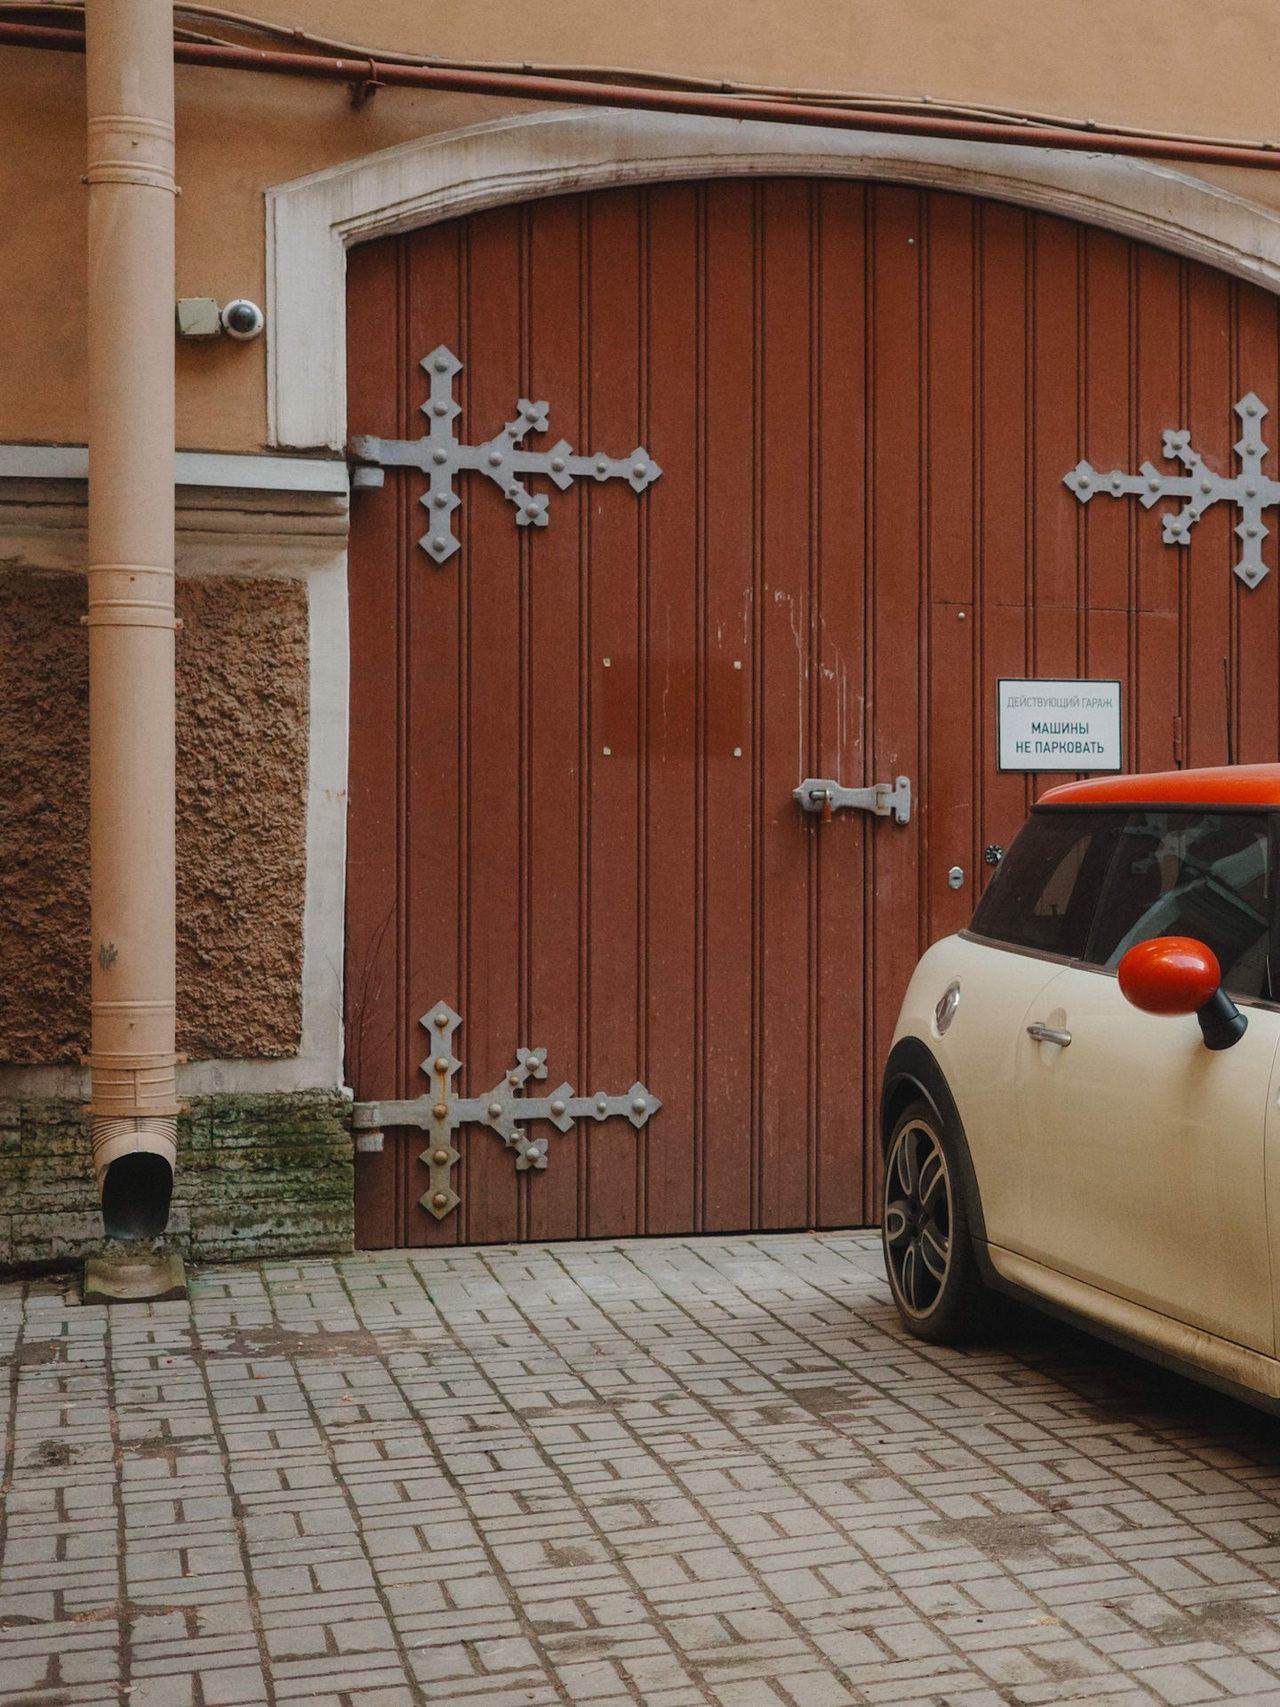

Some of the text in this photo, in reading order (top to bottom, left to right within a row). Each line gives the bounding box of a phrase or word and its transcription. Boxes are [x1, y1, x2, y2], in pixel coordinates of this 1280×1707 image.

[1007, 696, 1112, 709] ДЕЙСТВУЮЩИЙ ГАРАЖ
[1031, 722, 1089, 734] МАШИНЫ
[1016, 741, 1104, 753] НЕ ПАРКОВАТЬ
